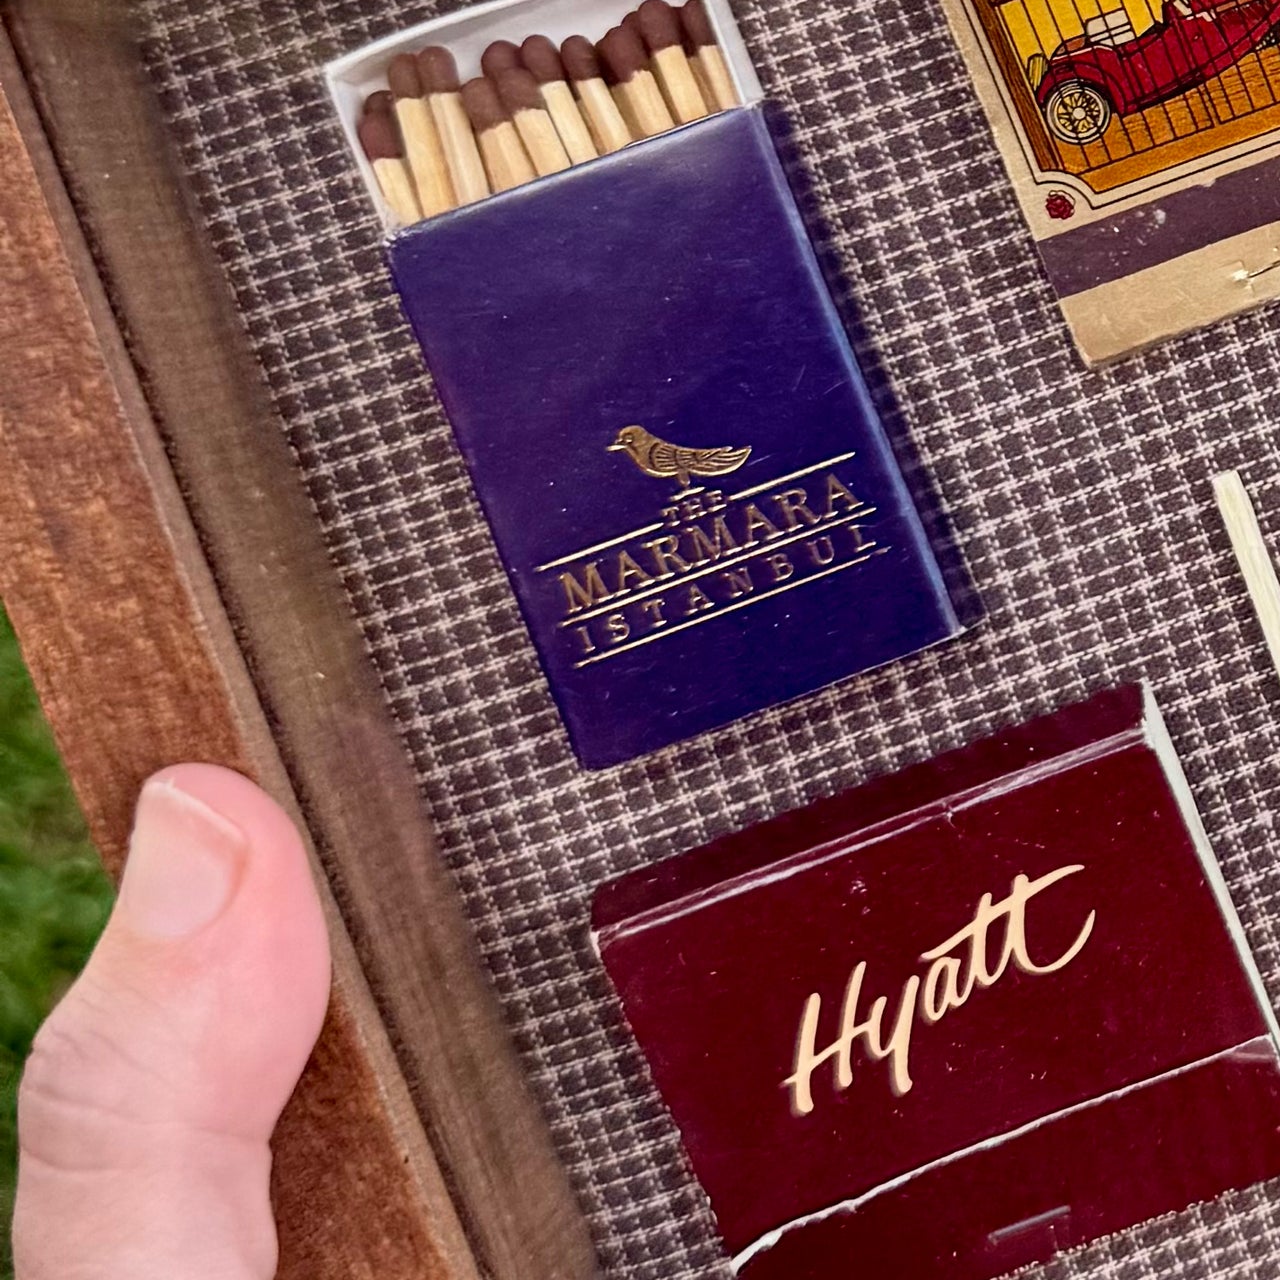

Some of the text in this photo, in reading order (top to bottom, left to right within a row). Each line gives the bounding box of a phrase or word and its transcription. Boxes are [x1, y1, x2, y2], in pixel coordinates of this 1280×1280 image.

[559, 474, 864, 613] MARMARA
[661, 489, 728, 527] THE
[575, 524, 876, 653] ISTANBUL
[780, 864, 1095, 1117] Hyatt
